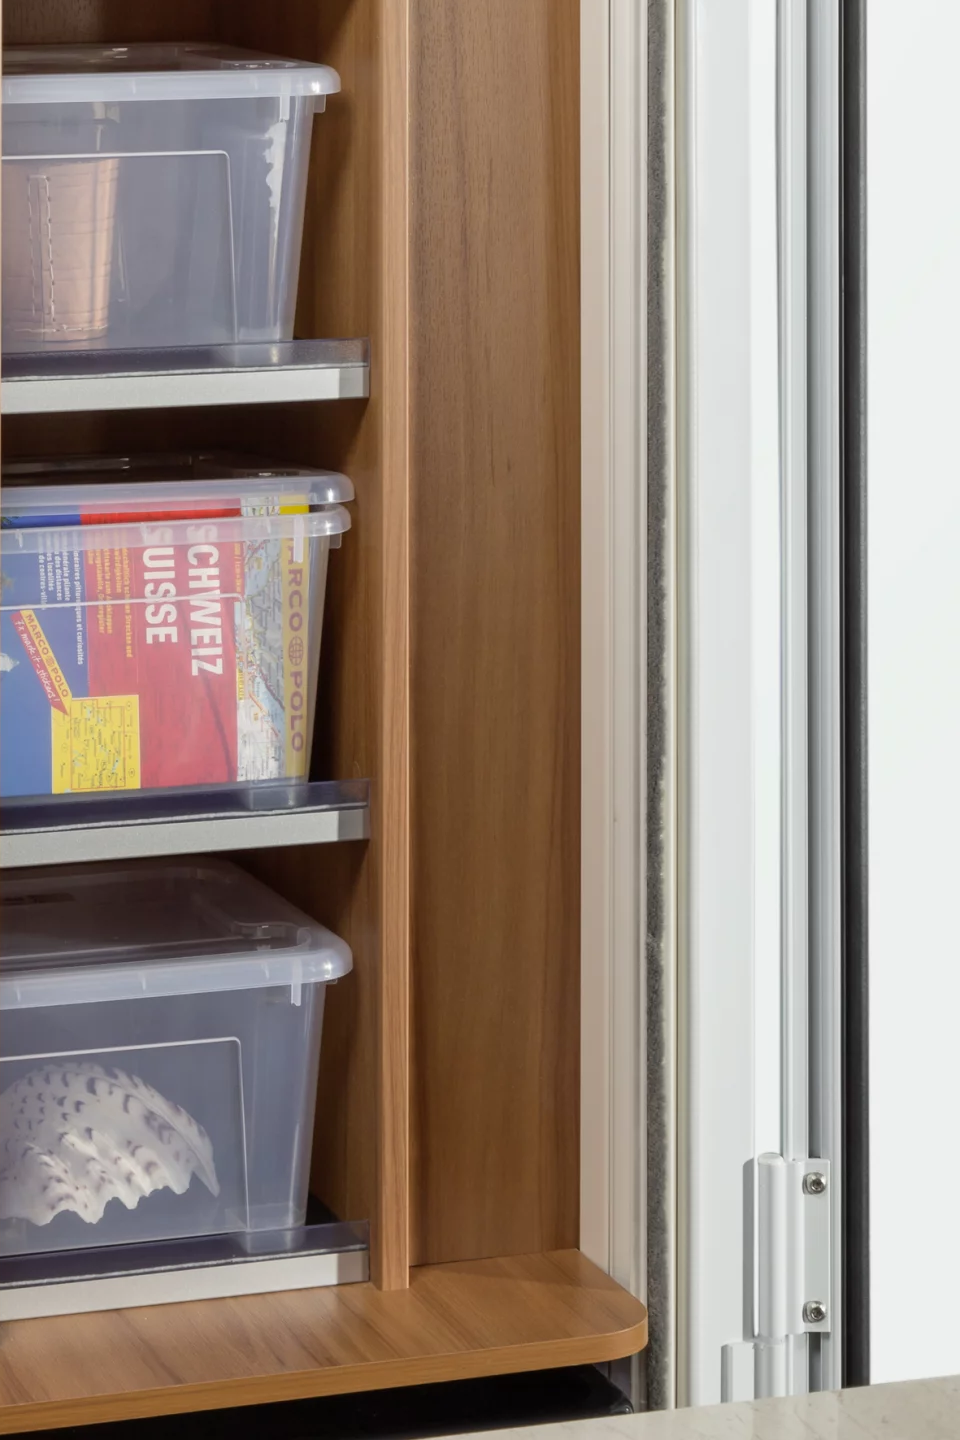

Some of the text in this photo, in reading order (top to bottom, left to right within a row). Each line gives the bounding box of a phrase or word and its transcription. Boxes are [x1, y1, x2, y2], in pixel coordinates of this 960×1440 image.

[47, 562, 55, 591] localités
[55, 569, 63, 601] distances
[62, 578, 71, 601] pliante
[141, 525, 179, 645] SUISSE
[186, 525, 224, 677] SCHWEIZ
[14, 619, 25, 632] 7x
[20, 633, 36, 655] mark
[76, 632, 85, 665] curiosités
[287, 538, 304, 752] RCO POLO
[25, 613, 69, 698] MARCO POLO
